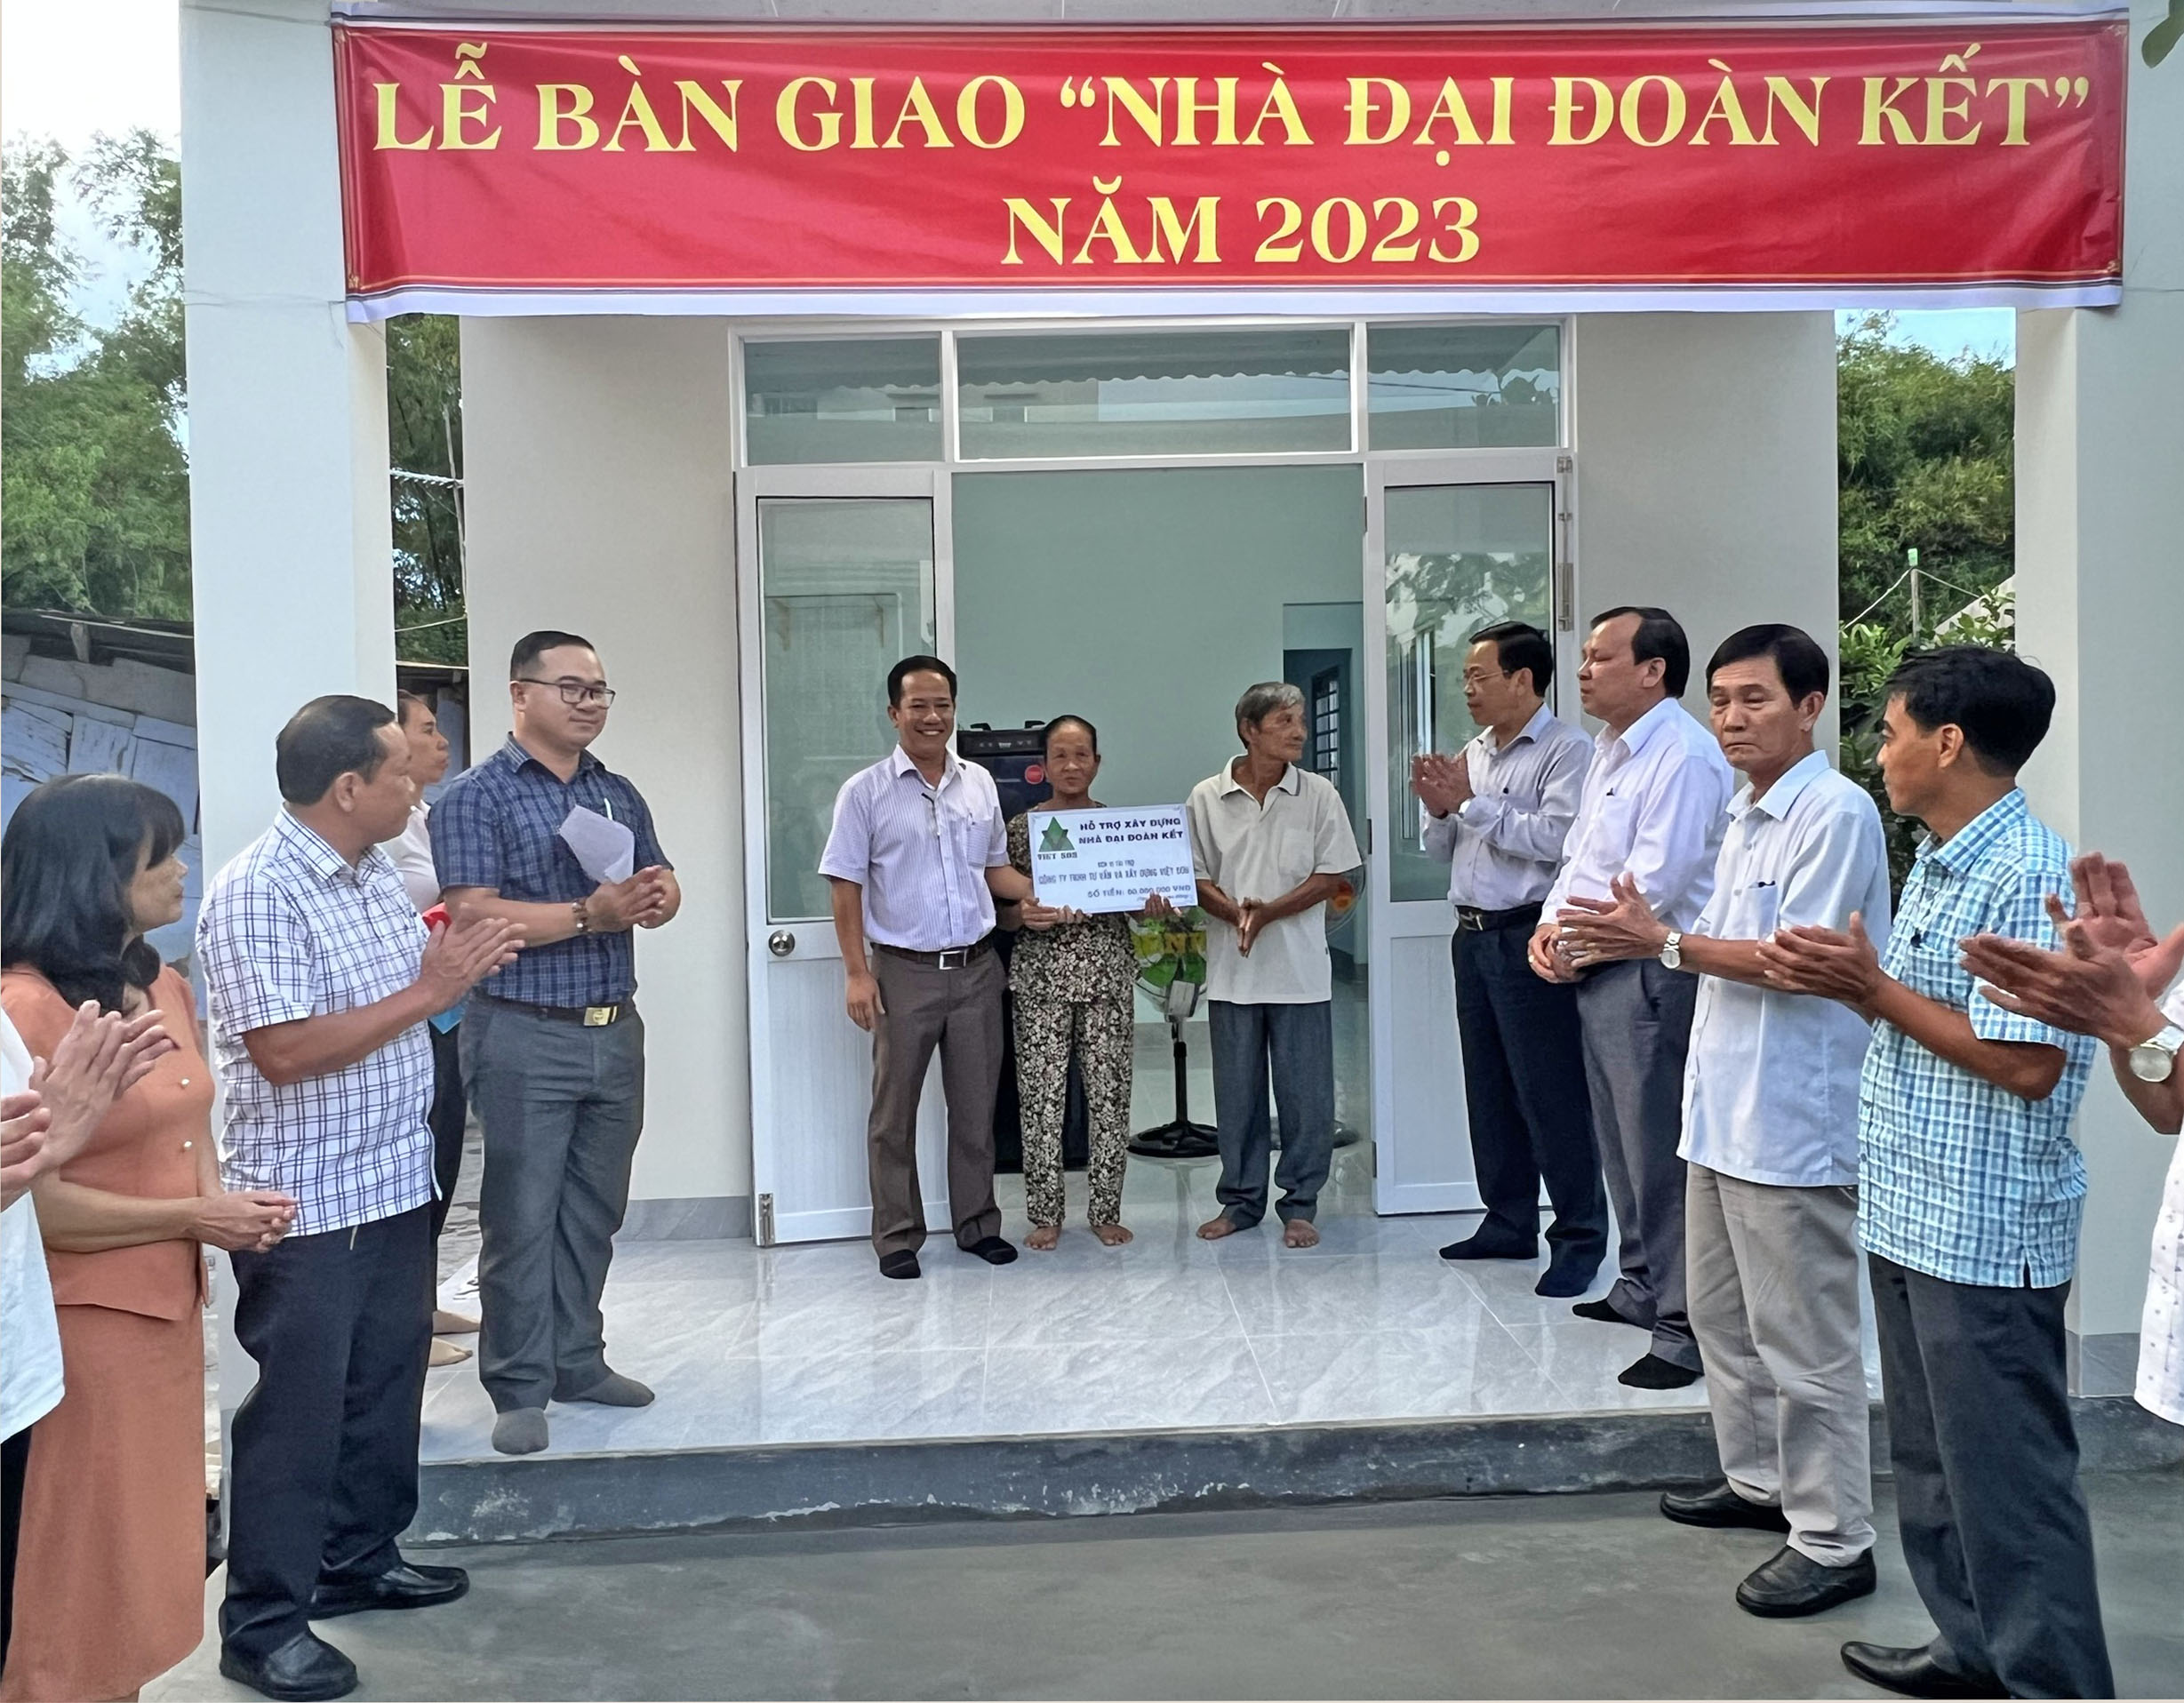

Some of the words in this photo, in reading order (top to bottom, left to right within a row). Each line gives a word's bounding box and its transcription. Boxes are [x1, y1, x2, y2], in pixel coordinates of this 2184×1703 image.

[372, 43, 502, 151] LỄ
[533, 55, 740, 152] BÀN
[775, 75, 1027, 150] GIAO
[1059, 61, 1314, 147] “NHÀ
[1343, 76, 1516, 166] ĐẠI
[1547, 59, 1828, 148] ĐOÀN
[1856, 43, 2091, 148] KẾT”
[1001, 175, 1222, 266] NĂM
[1254, 195, 1481, 264] 2023
[1078, 835, 1102, 844] NHÀ
[1127, 832, 1158, 843] ĐOÀN
[1162, 828, 1183, 840] KẾT
[1080, 820, 1096, 831] HỖ
[1099, 820, 1121, 831] TRỢ
[1124, 818, 1147, 829] XÂY
